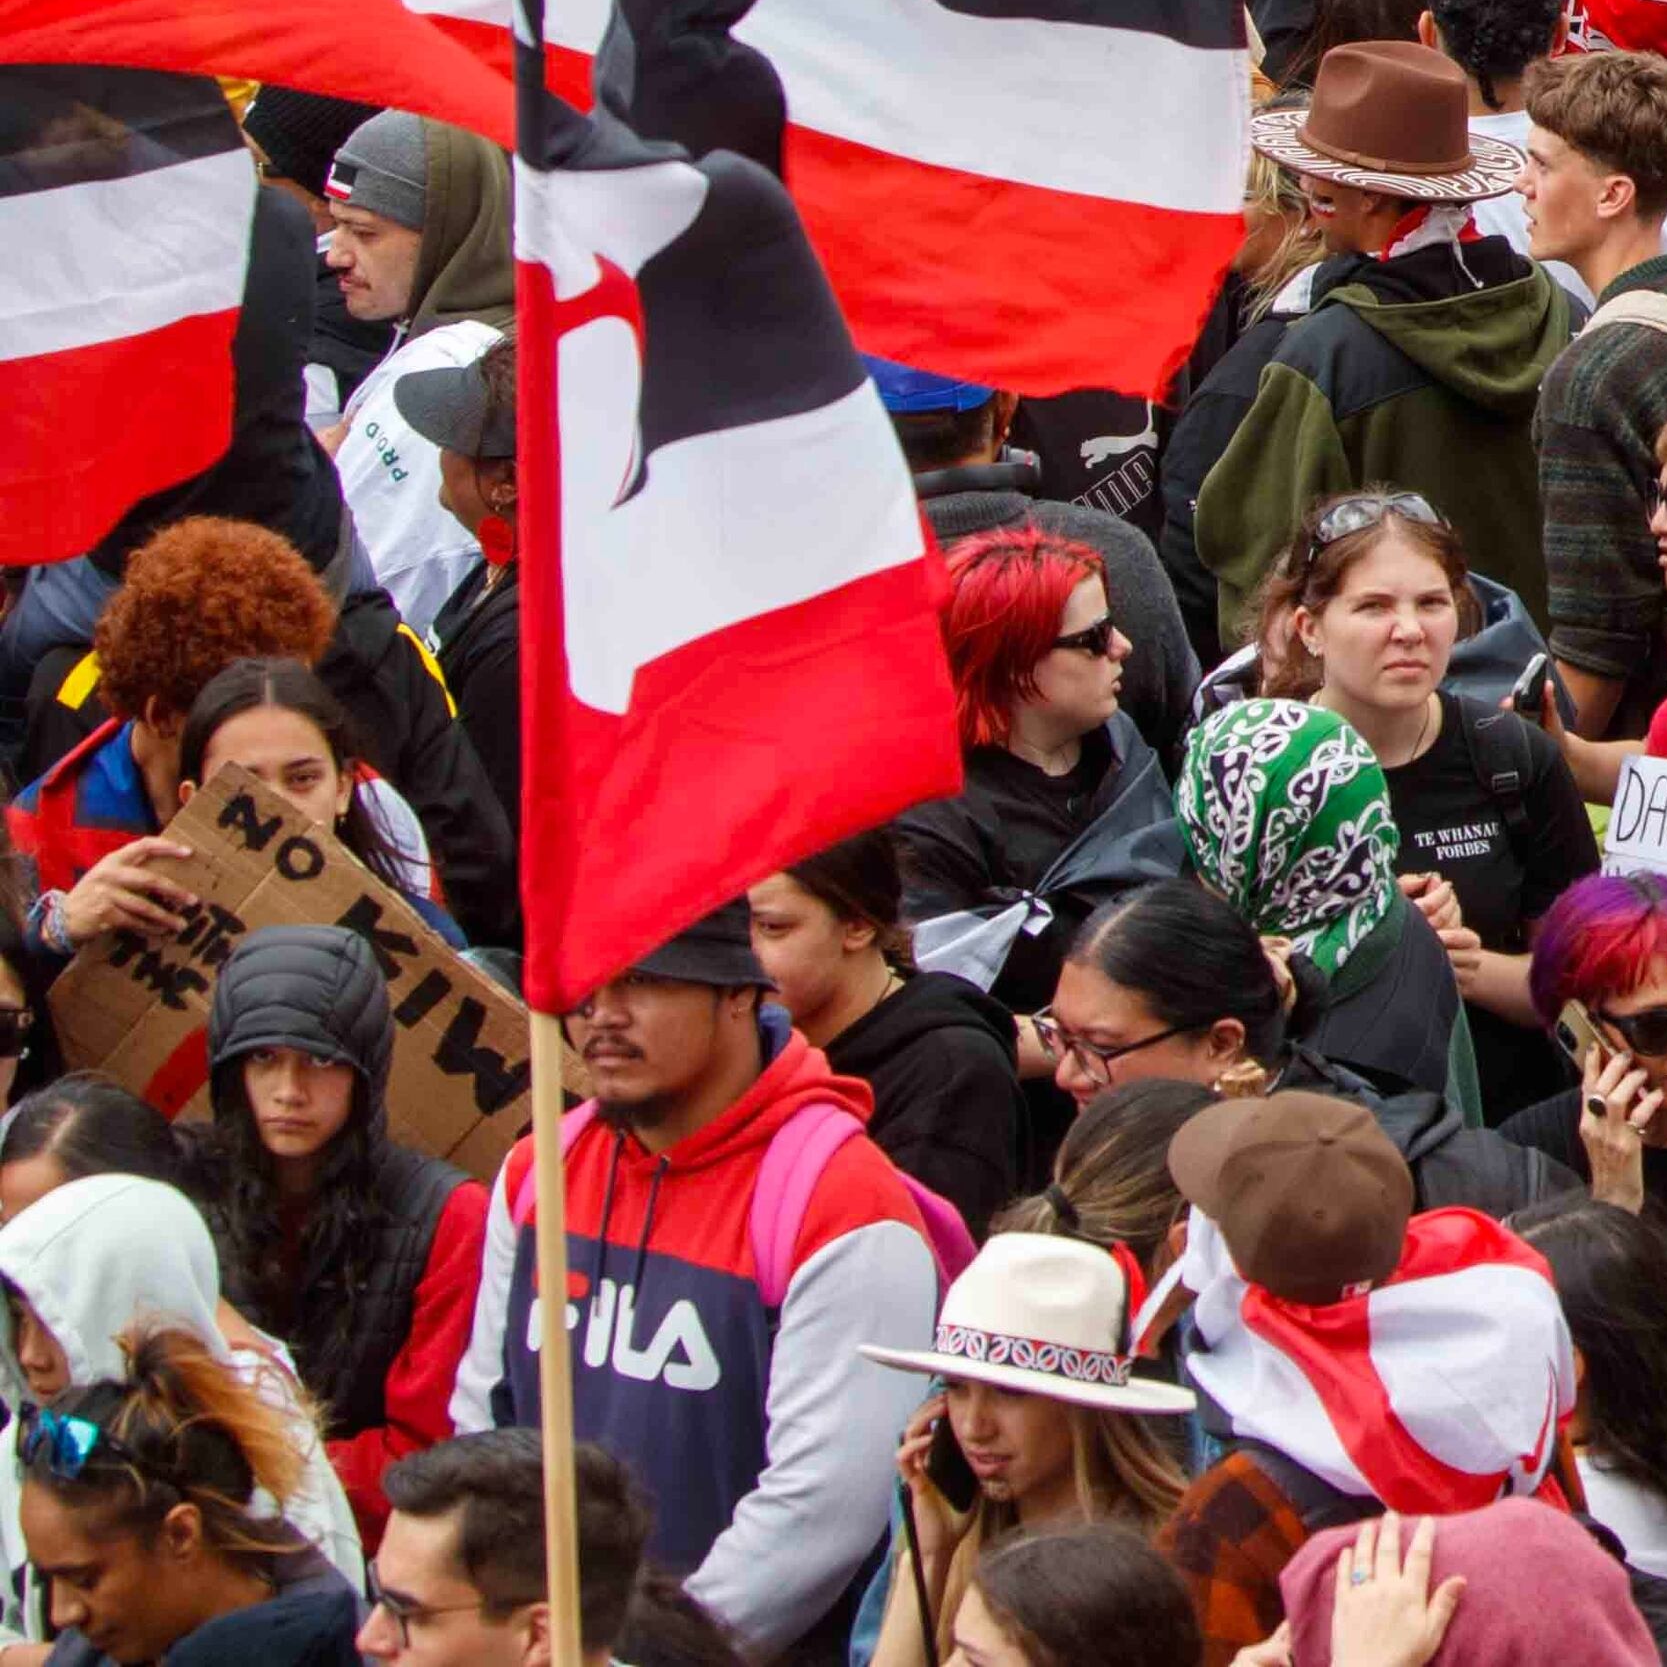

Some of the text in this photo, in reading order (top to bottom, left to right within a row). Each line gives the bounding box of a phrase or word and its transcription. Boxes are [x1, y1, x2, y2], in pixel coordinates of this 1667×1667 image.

[226, 793, 338, 882] NO
[1414, 832, 1436, 847] TE
[1436, 840, 1491, 861] FORBES
[526, 1270, 721, 1392] FILA
